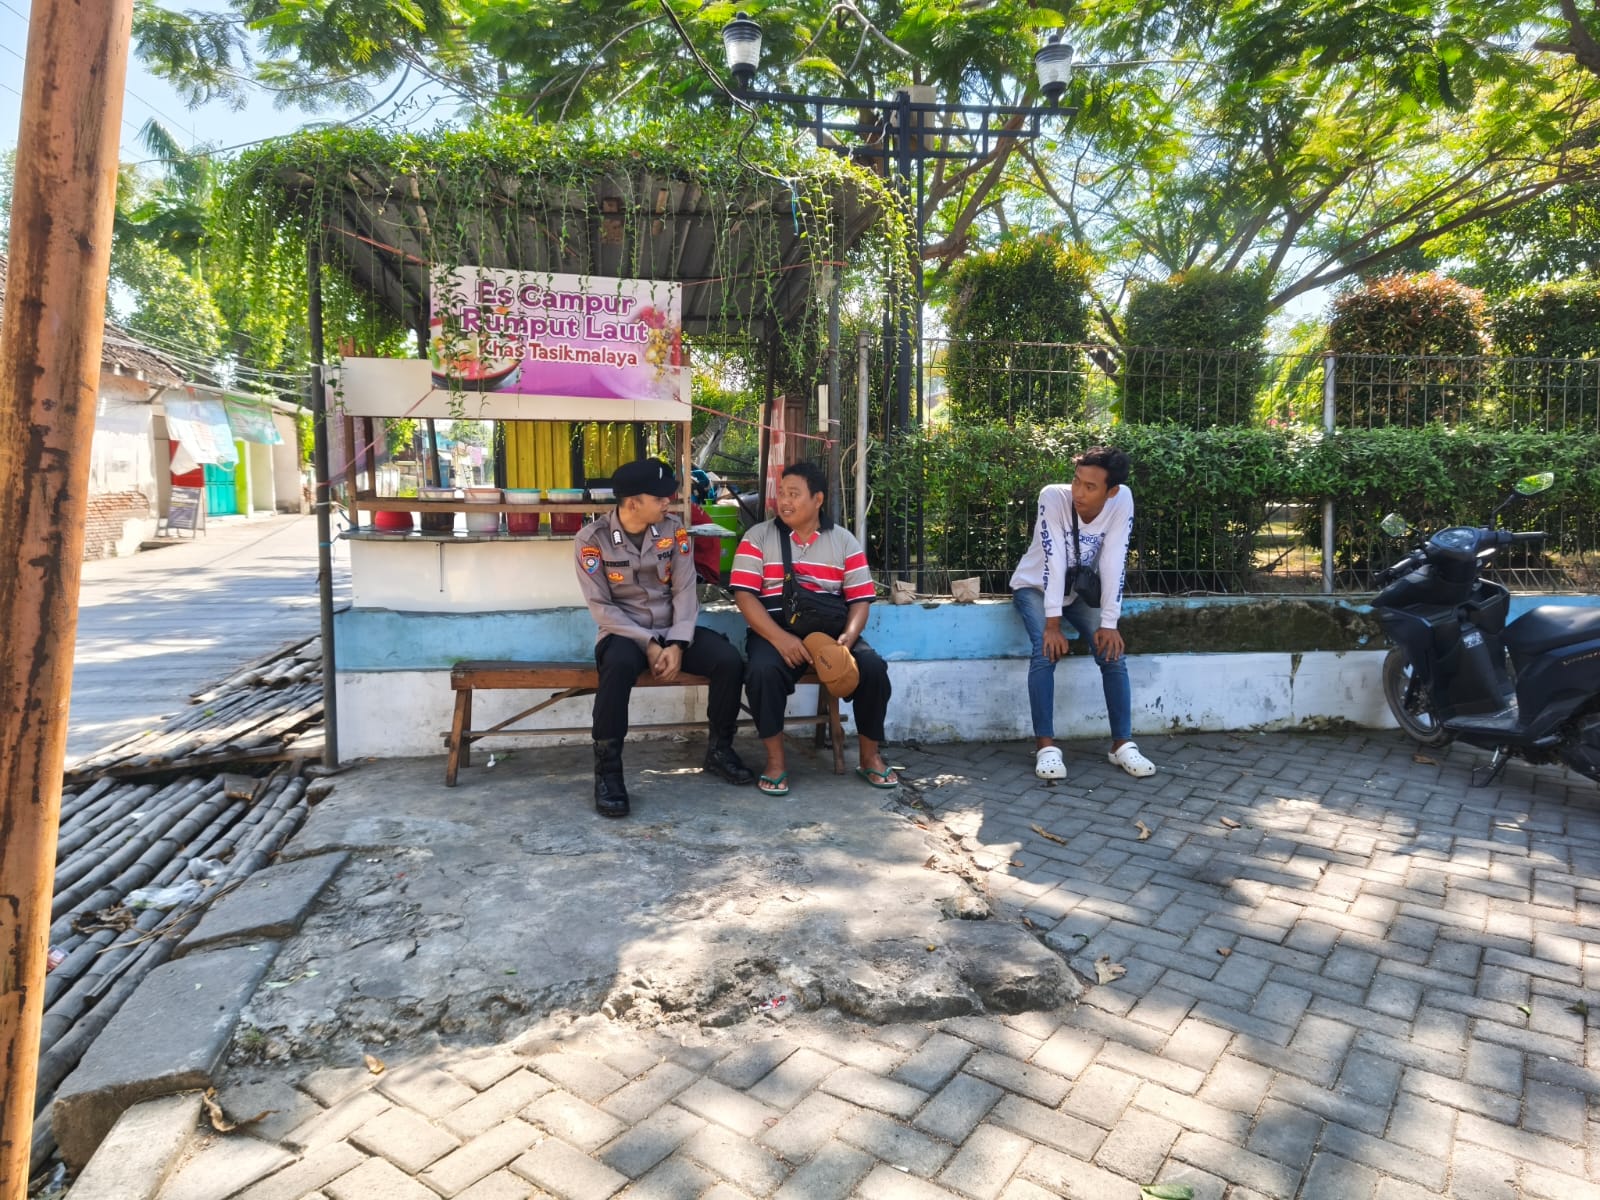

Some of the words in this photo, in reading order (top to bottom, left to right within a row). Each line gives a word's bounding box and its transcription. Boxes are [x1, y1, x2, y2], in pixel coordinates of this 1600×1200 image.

[476, 280, 514, 306] Es
[518, 284, 636, 316] Campur
[461, 306, 580, 341] Rumput
[584, 315, 649, 343] Laut
[478, 338, 526, 361] Khas
[528, 341, 639, 368] Tasikmalaya
